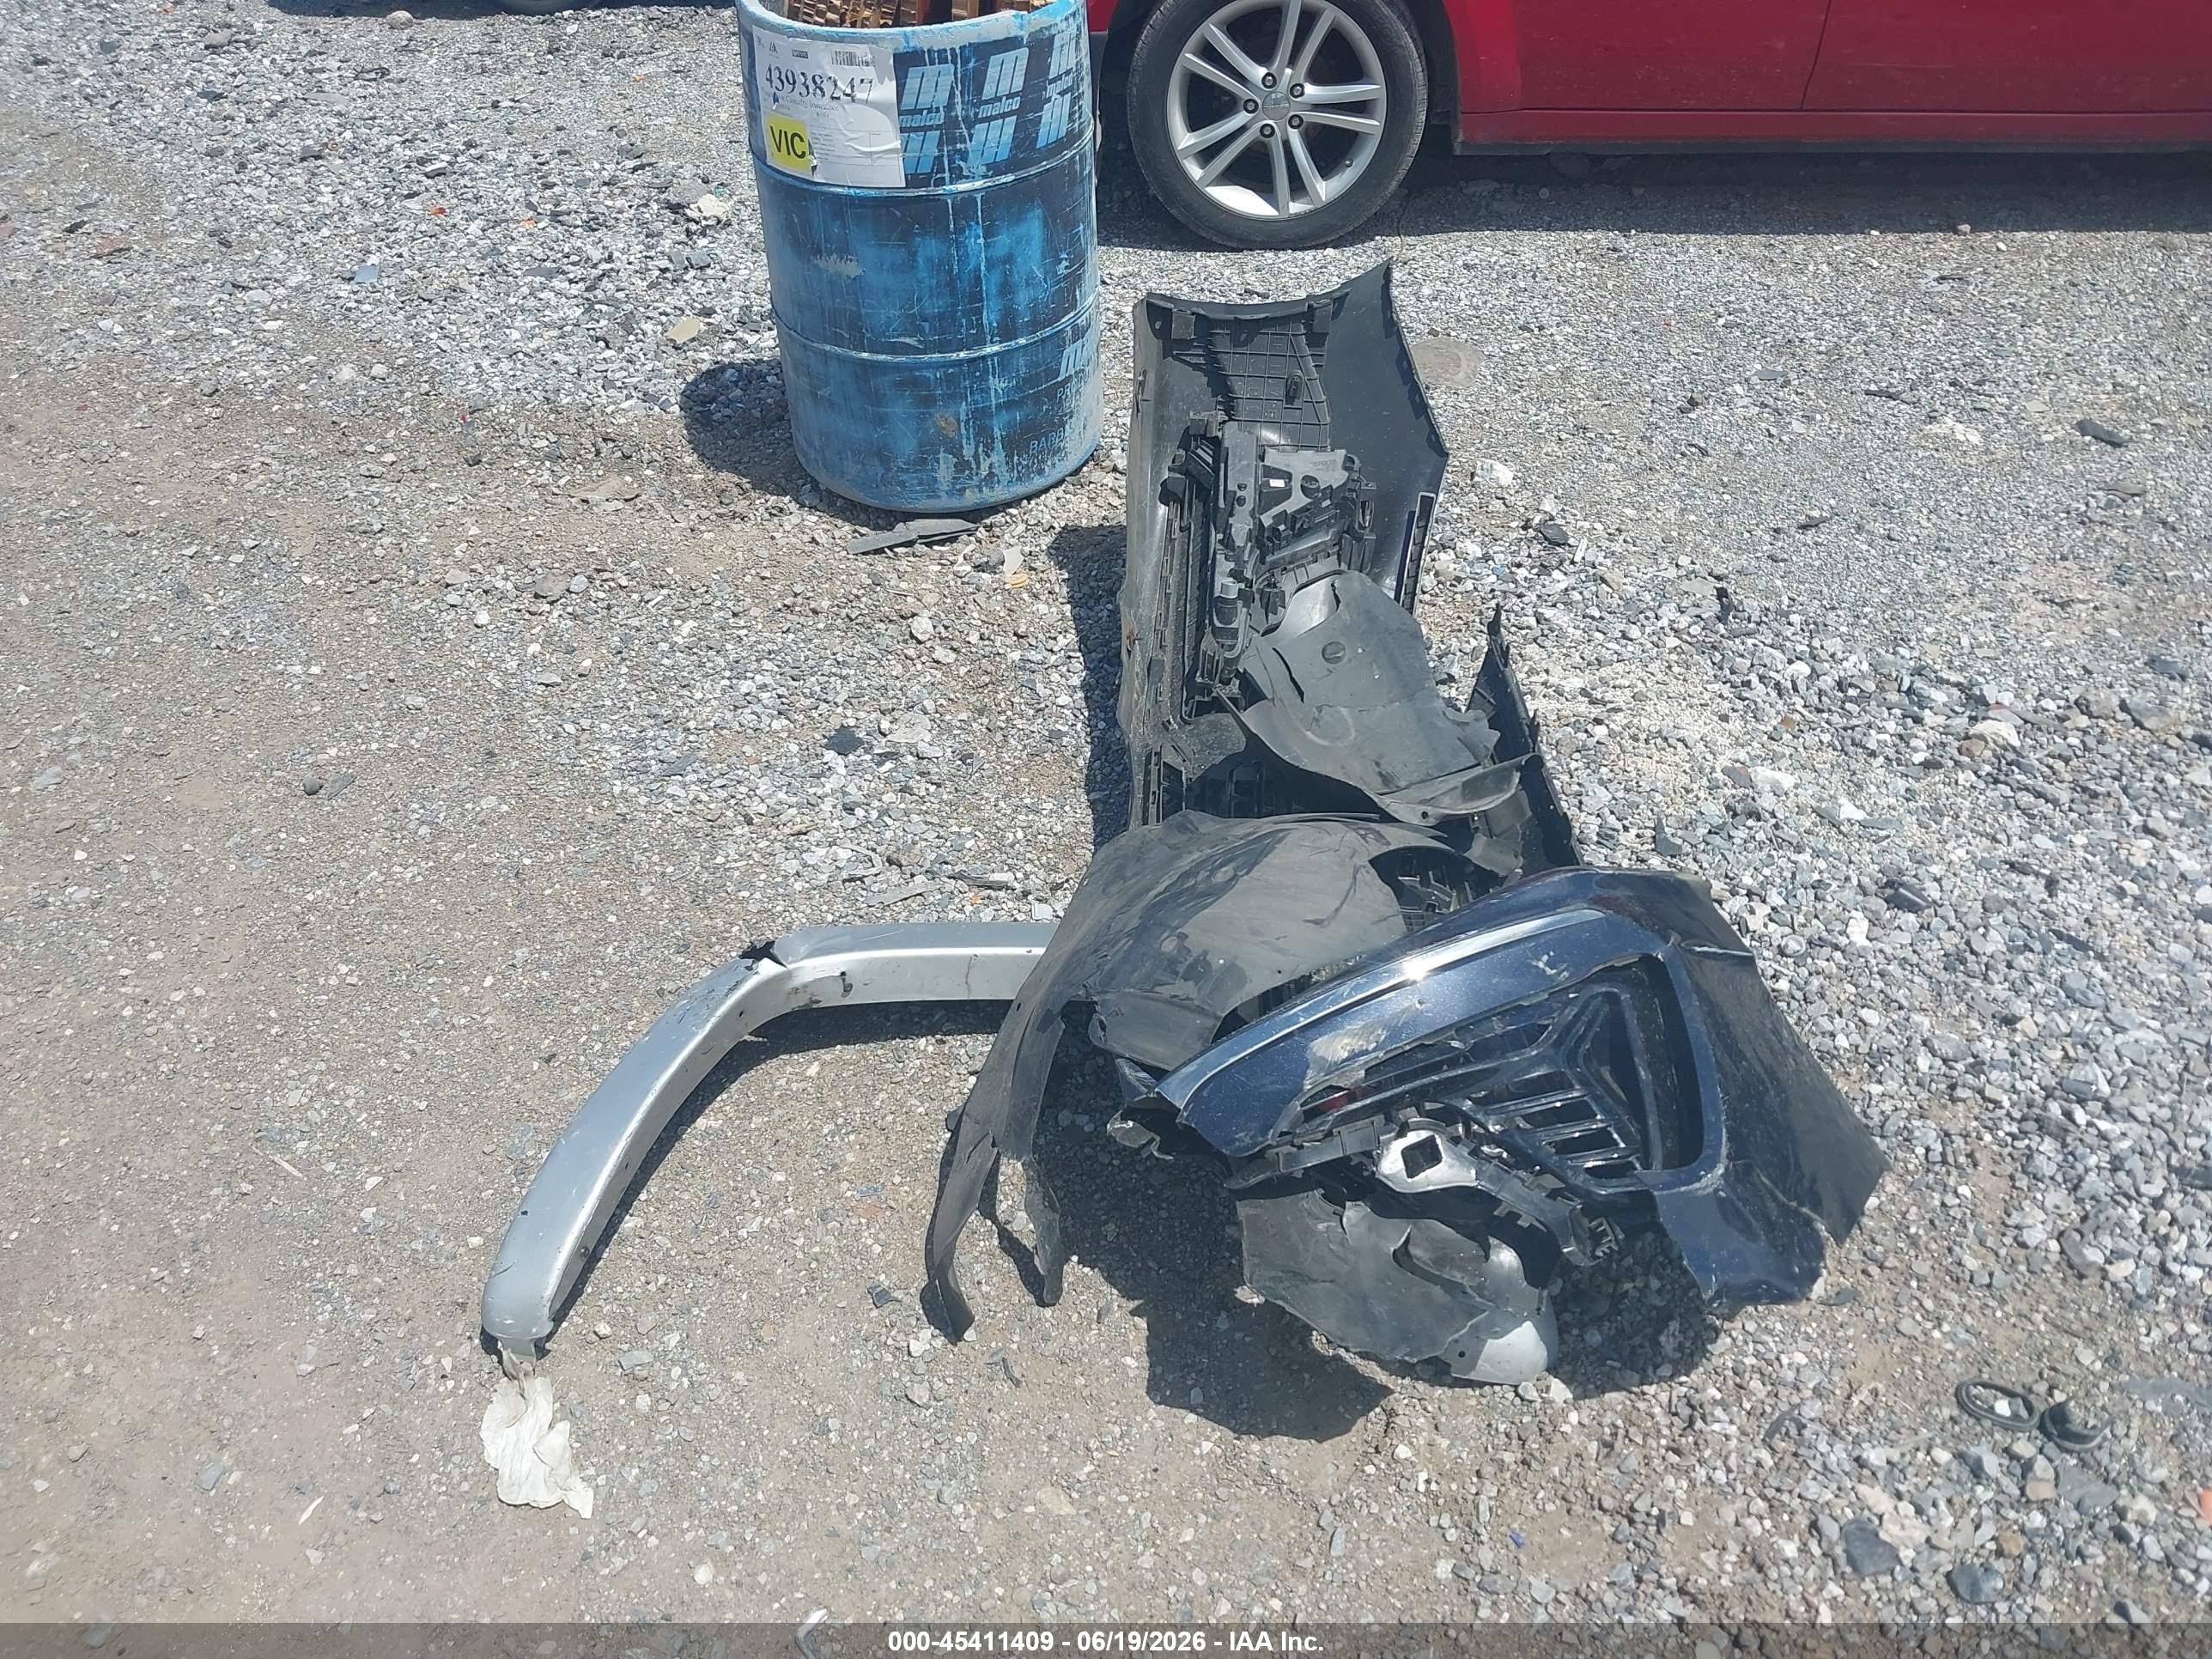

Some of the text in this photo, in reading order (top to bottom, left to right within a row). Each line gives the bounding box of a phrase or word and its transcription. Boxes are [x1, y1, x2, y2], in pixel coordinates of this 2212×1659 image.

[766, 64, 873, 103] 43938247
[899, 109, 944, 127] malco
[979, 96, 1020, 118] malco
[769, 125, 806, 159] VIC
